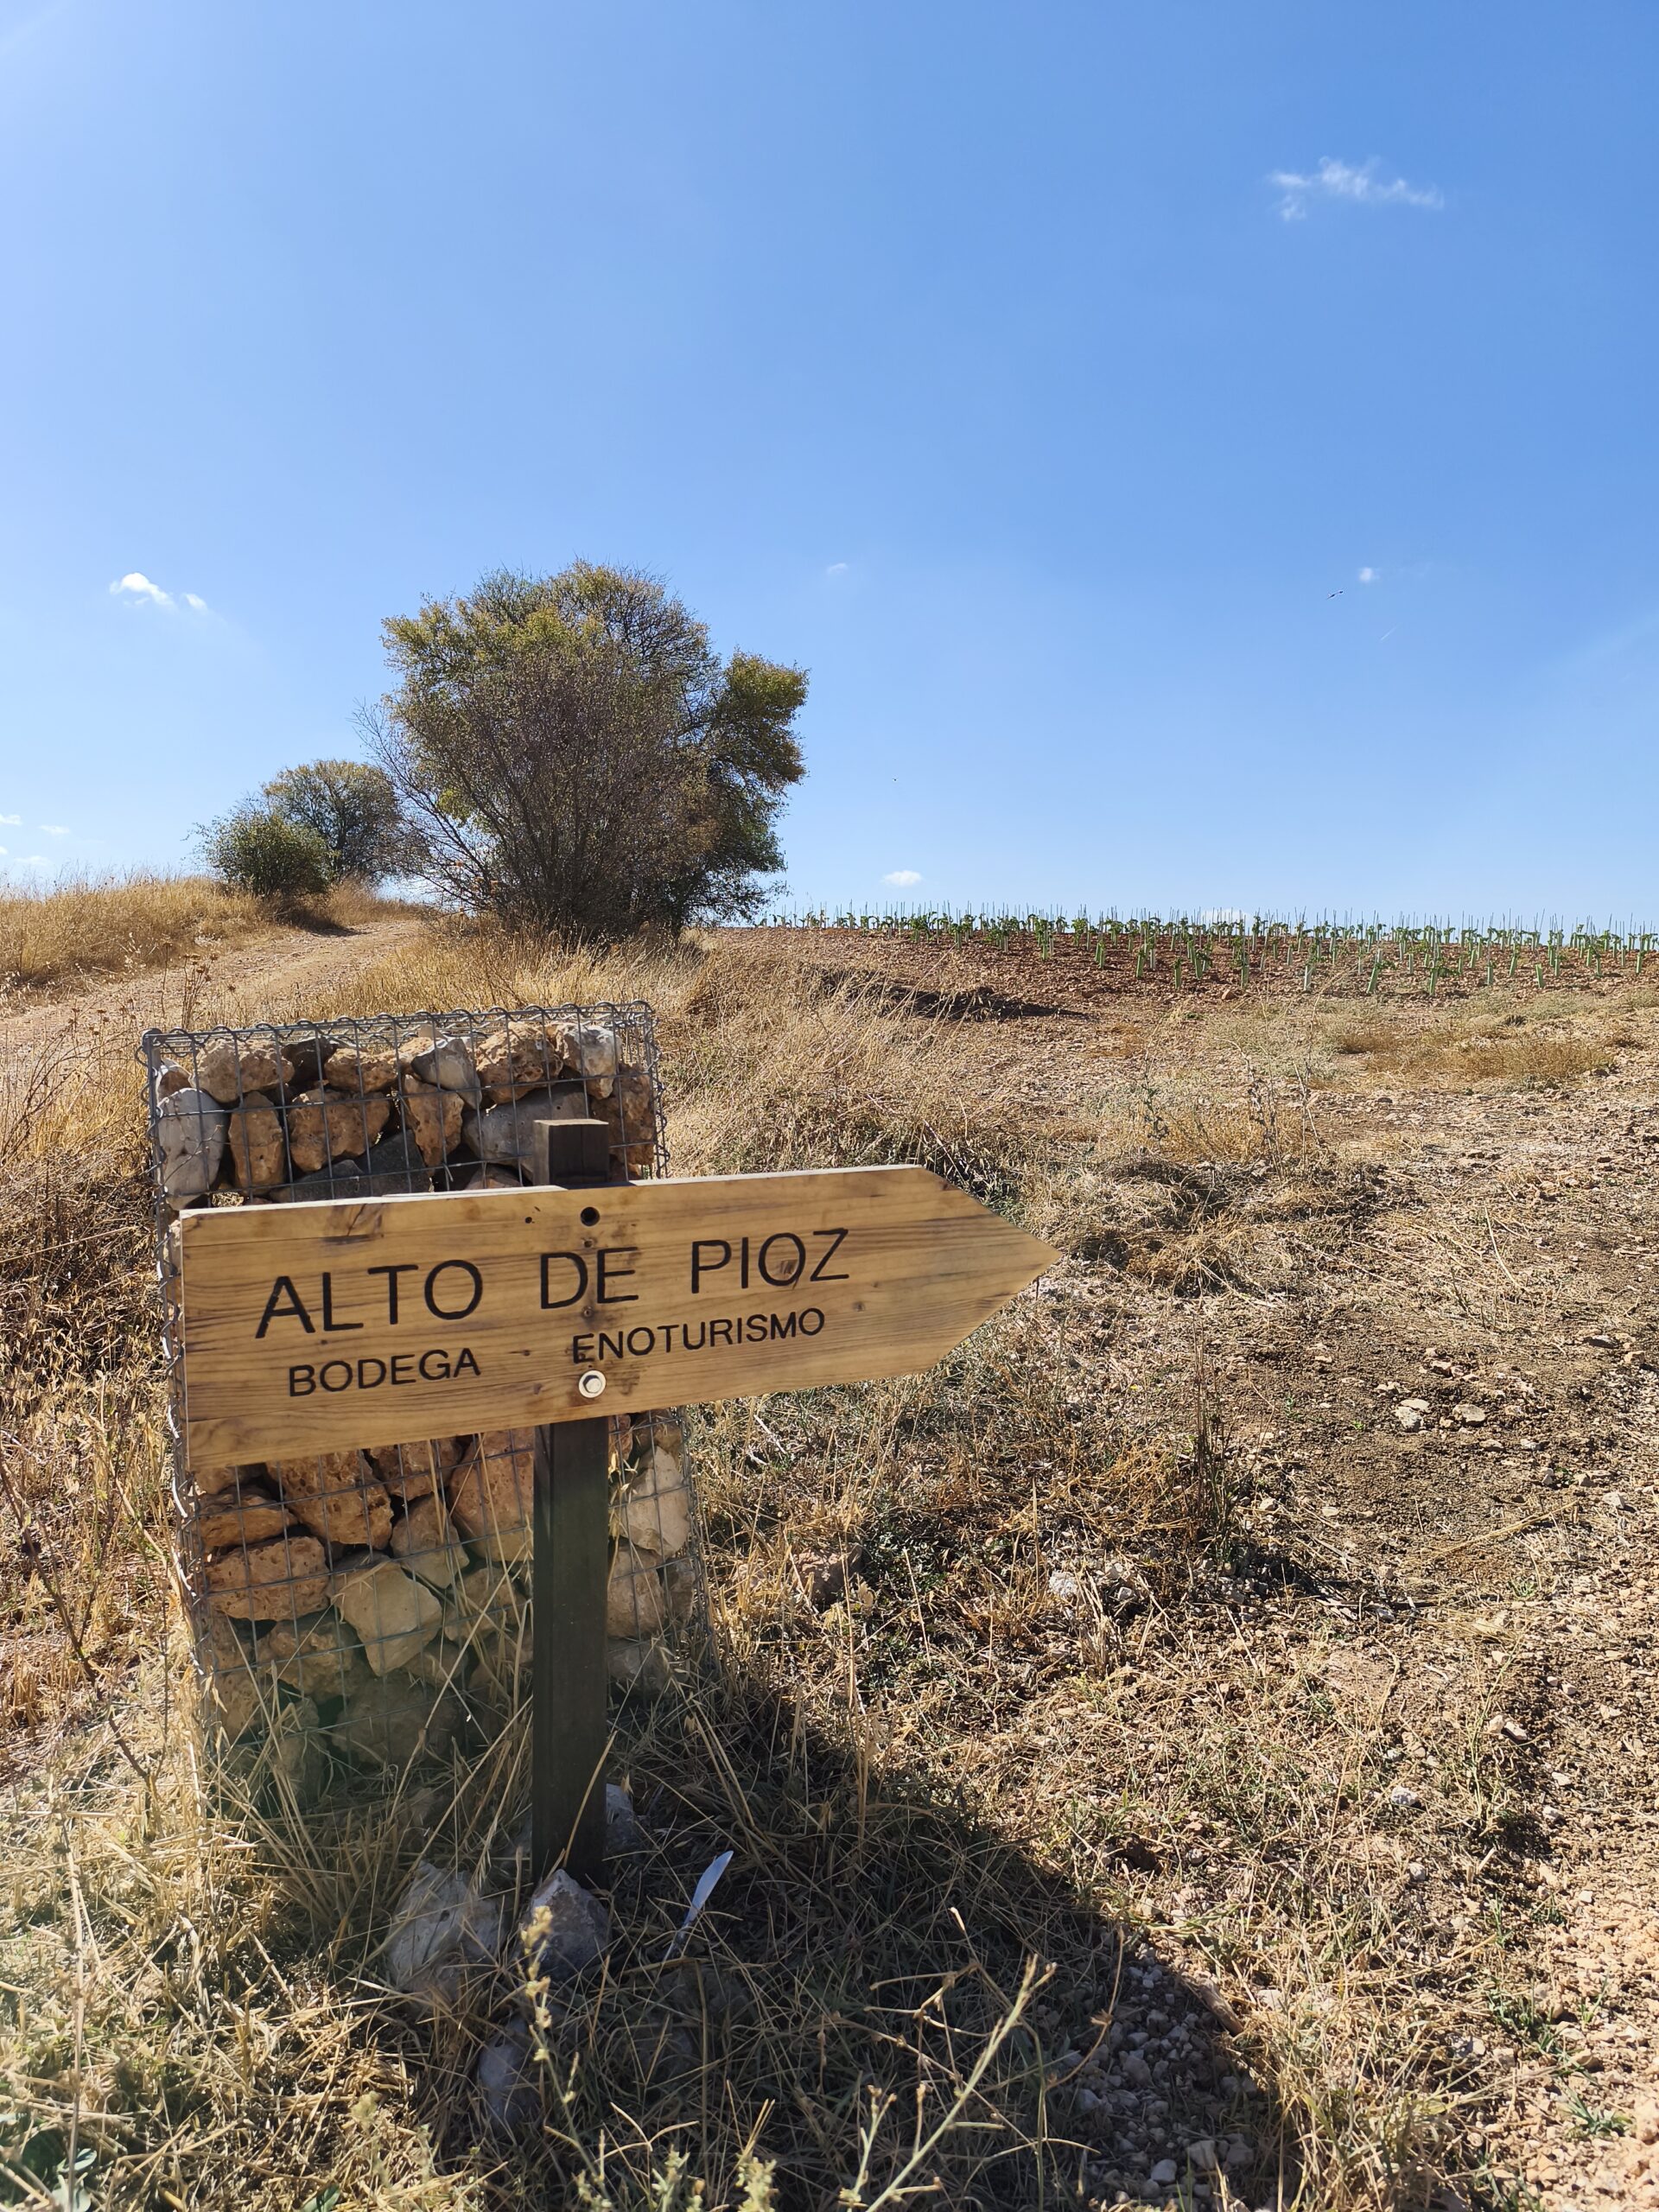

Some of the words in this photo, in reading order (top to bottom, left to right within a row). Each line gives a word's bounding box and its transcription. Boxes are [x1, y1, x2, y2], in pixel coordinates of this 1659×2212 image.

[255, 1259, 483, 1339] ALTO
[539, 1246, 639, 1310] DE
[690, 1227, 850, 1294] PIOZ
[289, 1347, 482, 1397] BODEGA
[569, 1307, 825, 1365] ENOTURISMO
